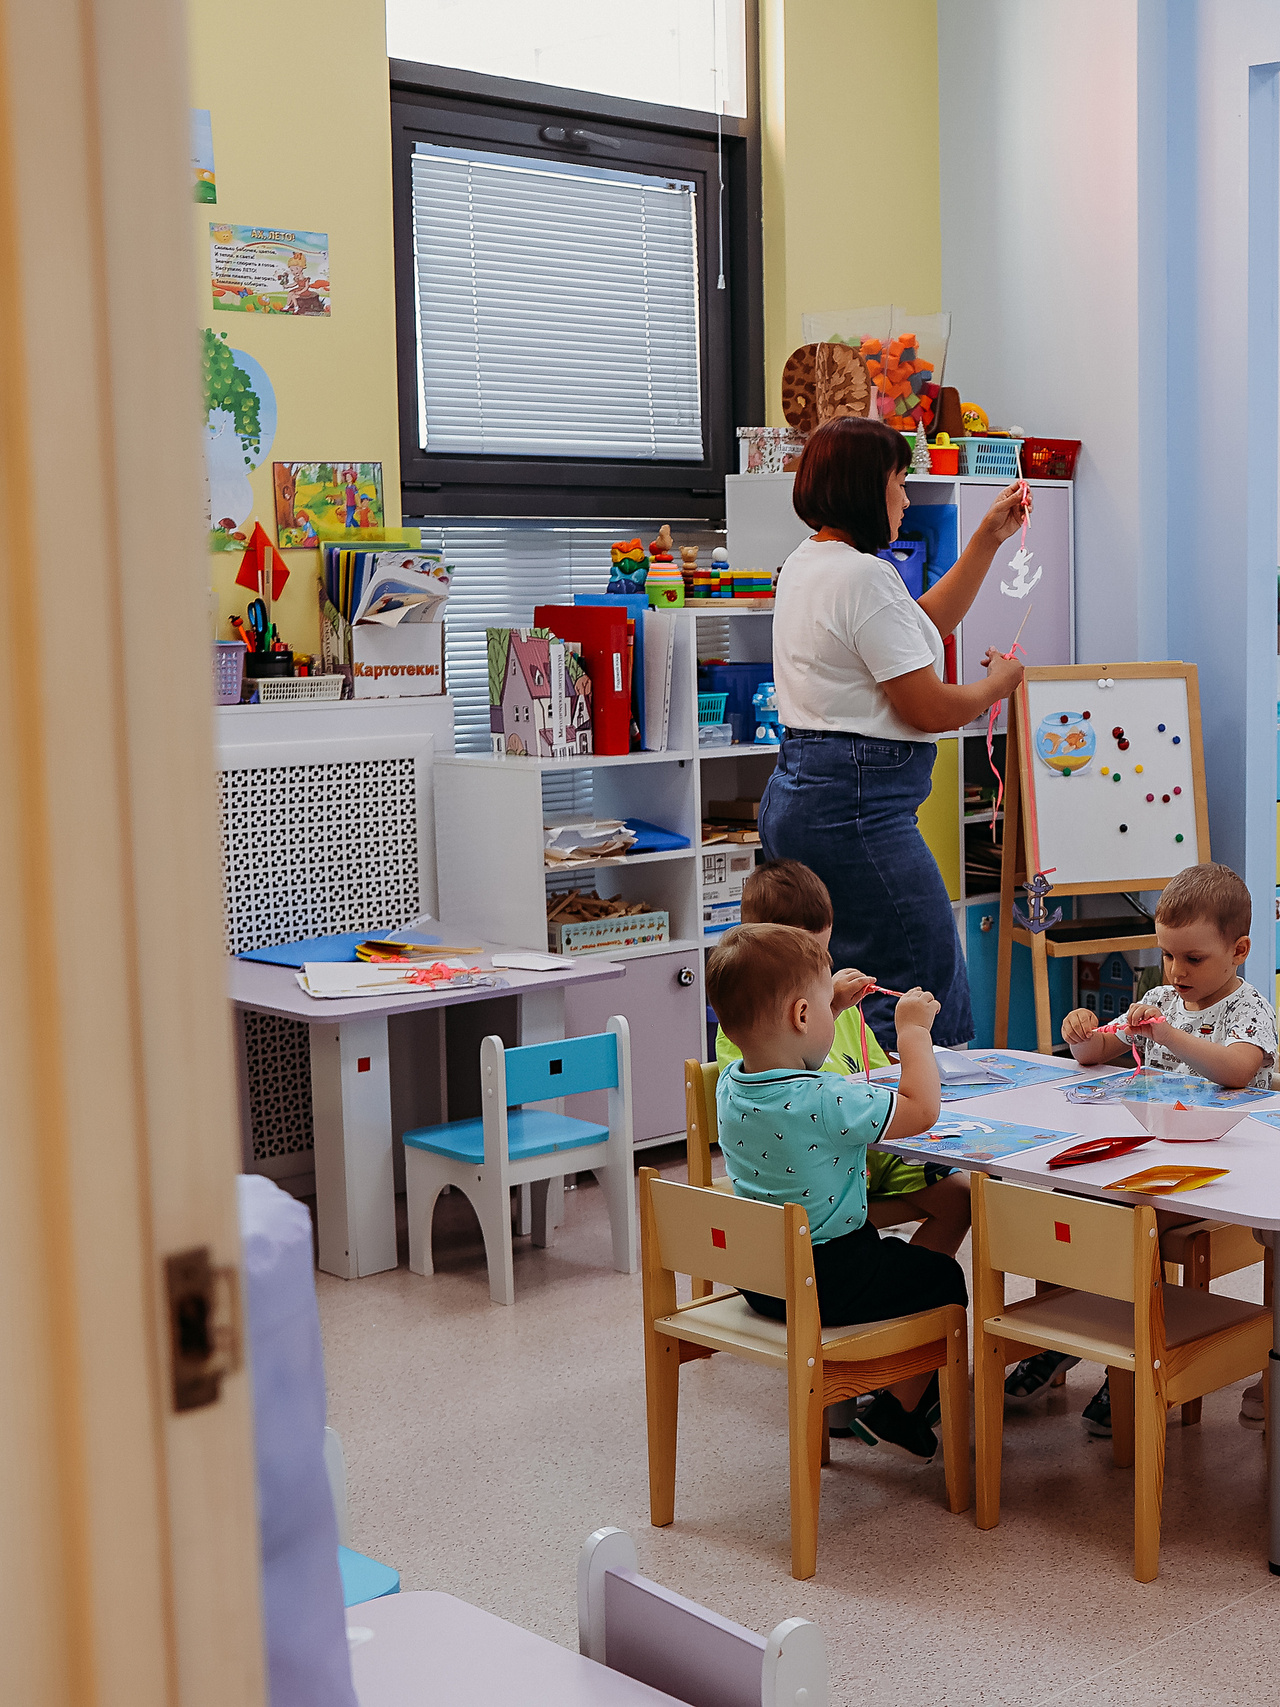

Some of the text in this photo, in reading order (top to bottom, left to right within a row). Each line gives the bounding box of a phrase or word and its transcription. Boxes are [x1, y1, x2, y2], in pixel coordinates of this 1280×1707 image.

[250, 229, 296, 242] АХ, ЛЕТО!
[354, 662, 439, 680] Картотеки:
